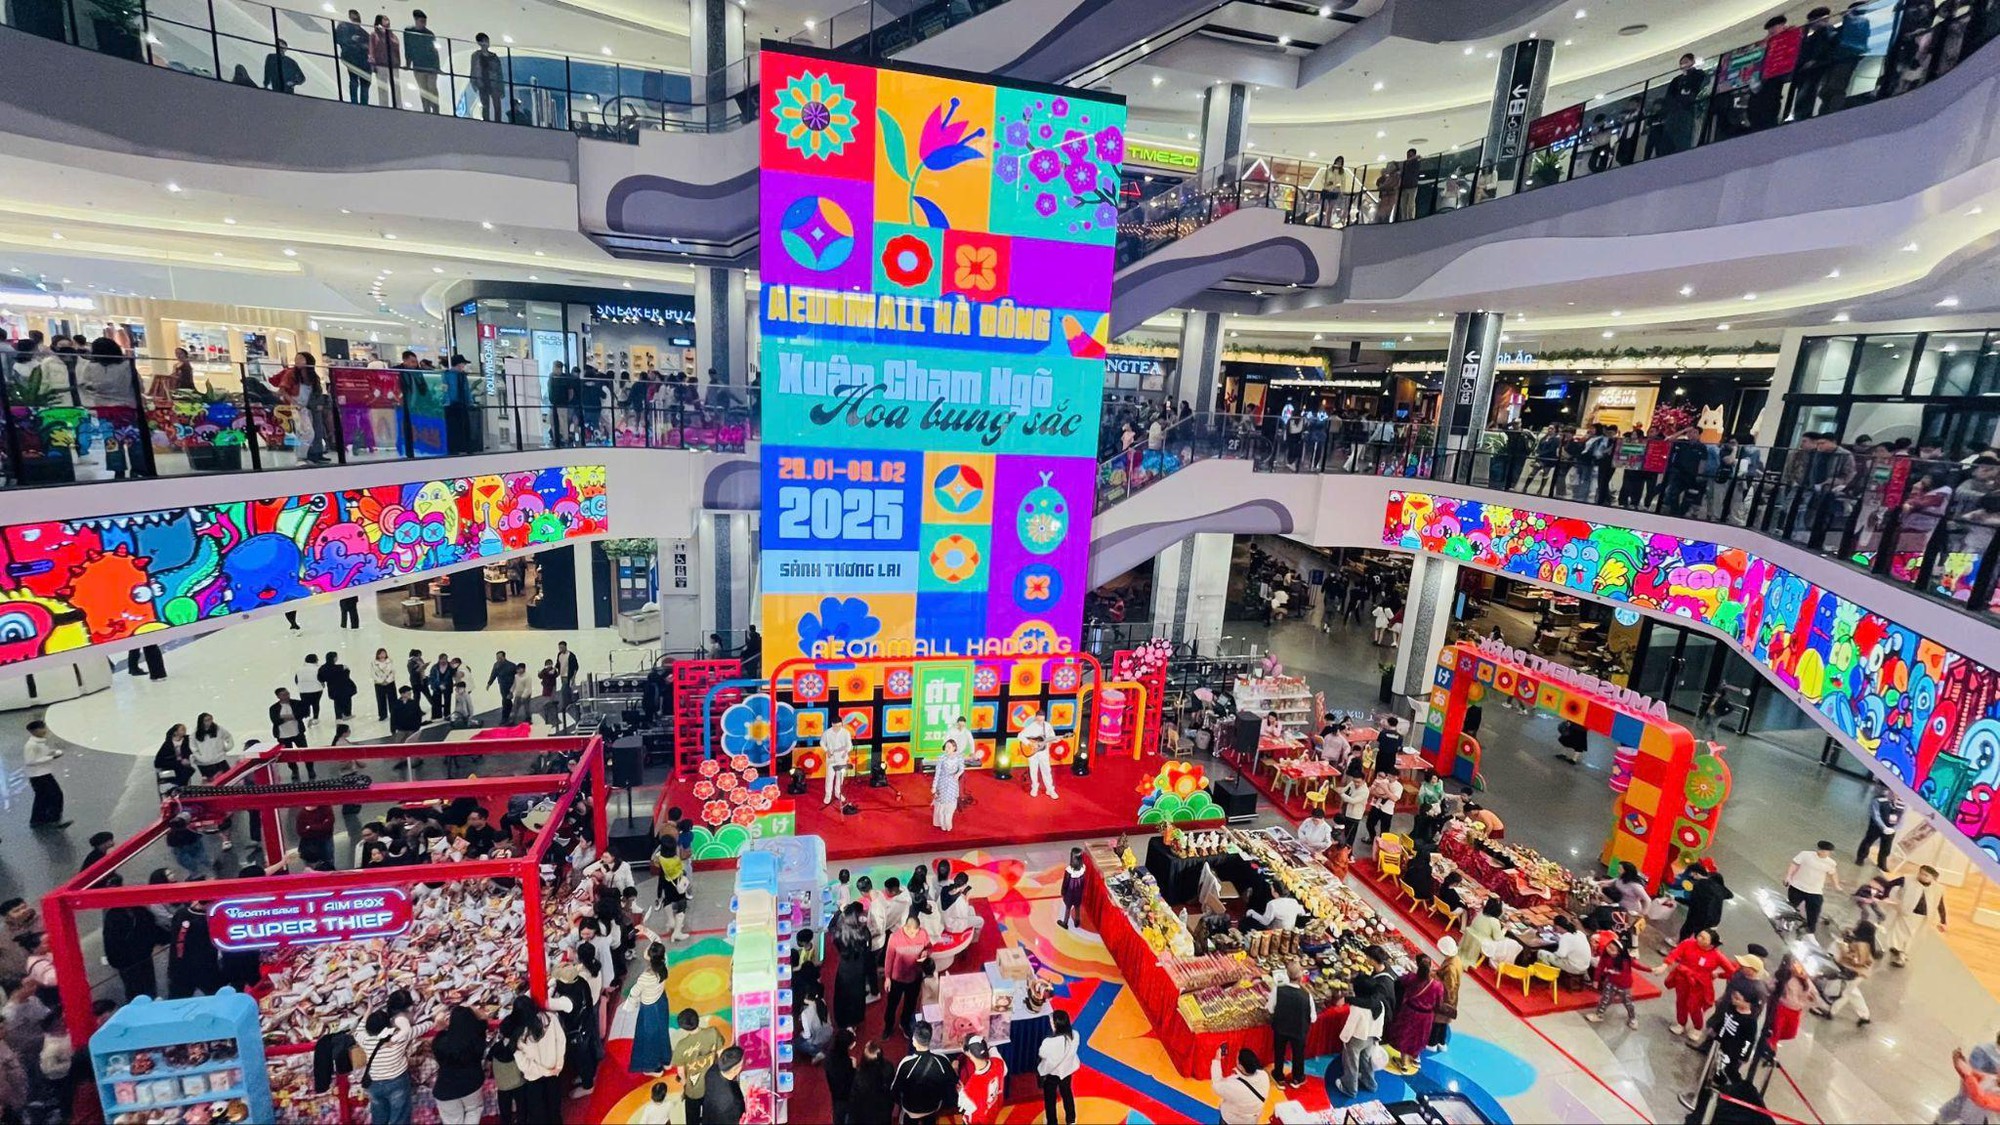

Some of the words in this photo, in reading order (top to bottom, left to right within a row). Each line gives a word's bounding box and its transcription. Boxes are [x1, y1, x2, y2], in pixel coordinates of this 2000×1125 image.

[596, 305, 660, 319] SNEAKER
[767, 286, 925, 332] AEONMALL
[933, 294, 971, 336] HÀ
[979, 299, 1051, 341] ĐÔNG
[484, 341, 495, 395] INFORMATION
[1105, 358, 1162, 375] NGTEA
[778, 352, 874, 399] Xuân
[989, 367, 1053, 416] Ngõ
[1598, 395, 1637, 404] MOCHA
[810, 383, 912, 428] Hoa
[919, 396, 1016, 447] bung
[1022, 399, 1083, 437] sắc
[1228, 440, 1240, 450] 2F
[779, 486, 904, 540] 2025
[780, 560, 821, 577] SẢNH
[878, 563, 901, 577] LAI
[811, 637, 958, 659] AEONMALL
[967, 636, 1072, 655] HADONG
[1202, 665, 1213, 675] 1F
[324, 900, 350, 912] AIM
[353, 897, 385, 908] BOX
[229, 919, 317, 940] SUPER
[321, 911, 394, 931] THIEF
